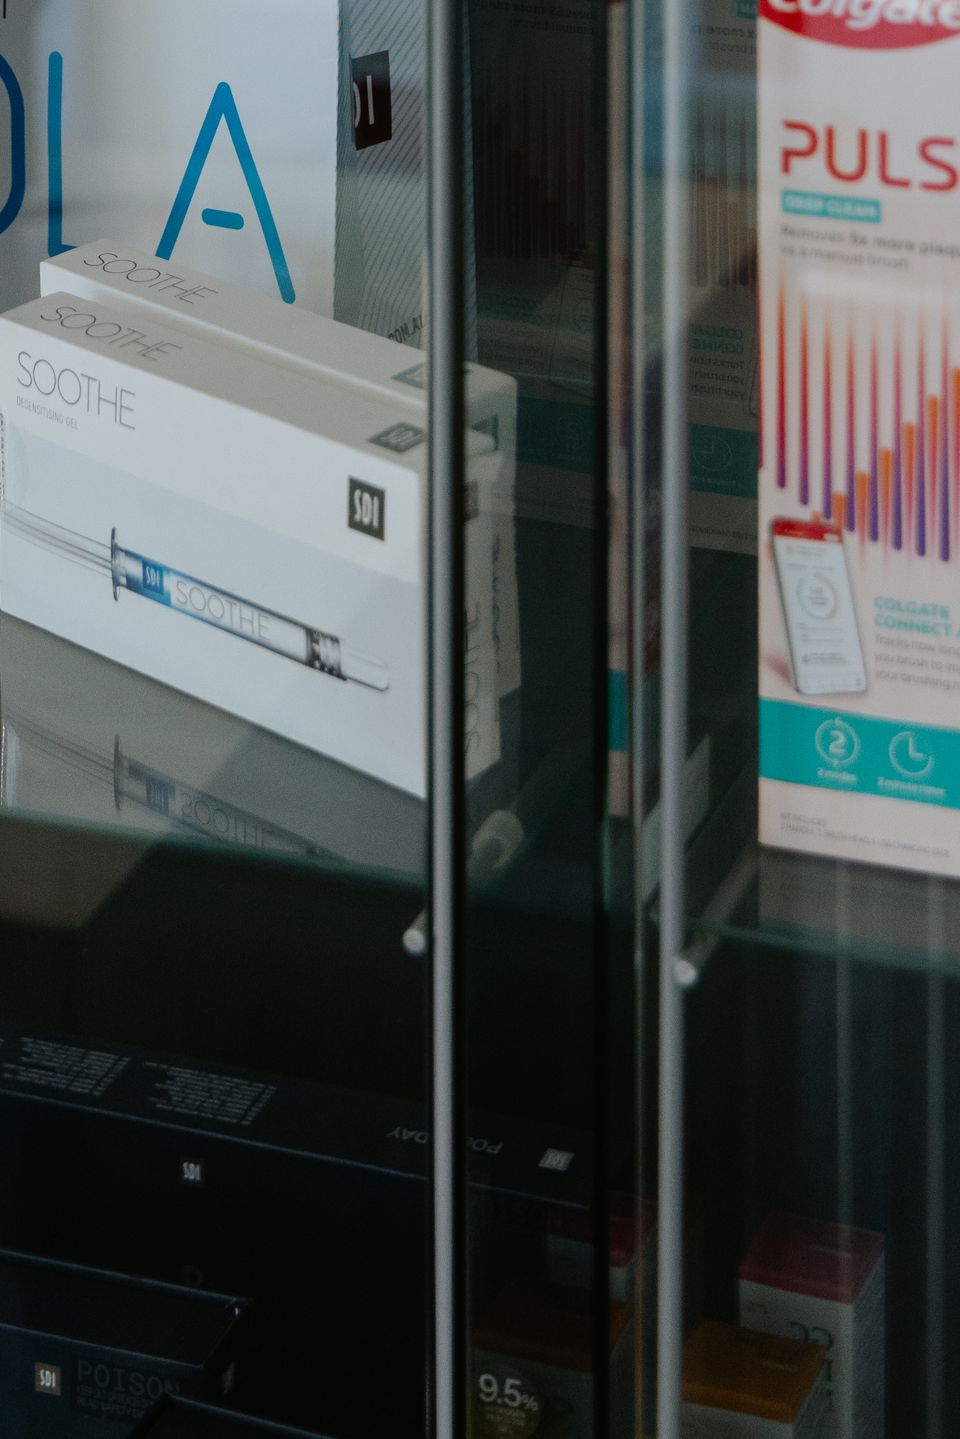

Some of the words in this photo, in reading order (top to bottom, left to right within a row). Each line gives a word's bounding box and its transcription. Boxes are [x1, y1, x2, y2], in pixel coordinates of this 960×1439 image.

[781, 120, 959, 193] PULS
[83, 252, 219, 304] SOOTHE
[40, 306, 183, 361] SOOTHE
[17, 351, 136, 430] SOOTHE
[16, 395, 64, 425] DESENSITISING
[66, 417, 78, 430] GEL
[353, 488, 379, 529] SDI
[145, 565, 160, 588] SDI
[175, 580, 271, 641] SOOTHE
[182, 1161, 202, 1182] SDI
[38, 1369, 57, 1390] SDI
[478, 1372, 540, 1412] 9.5%
